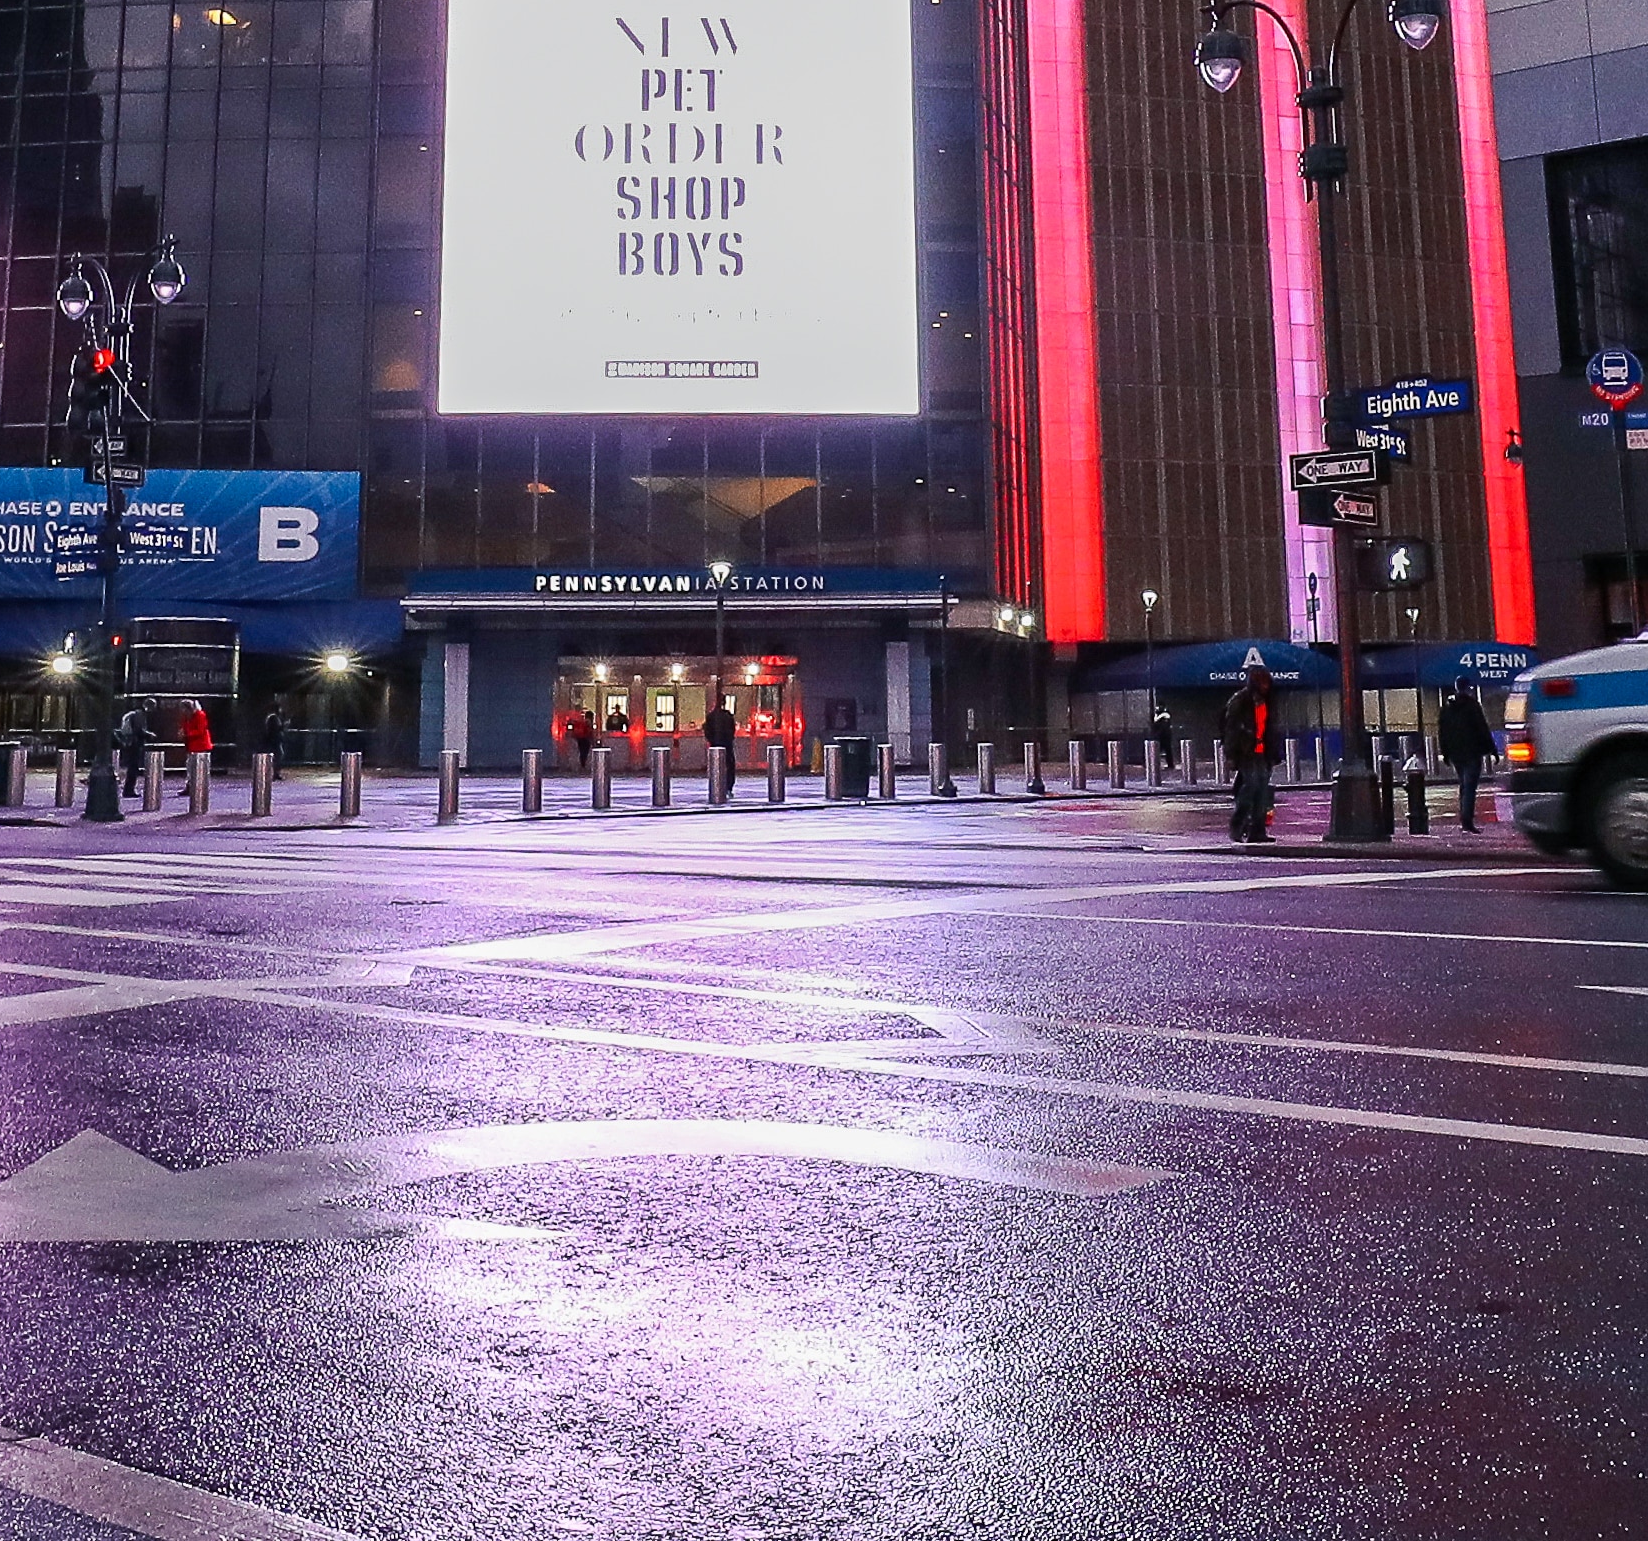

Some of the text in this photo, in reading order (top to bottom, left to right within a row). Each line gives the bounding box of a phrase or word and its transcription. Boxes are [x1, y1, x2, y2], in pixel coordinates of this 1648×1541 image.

[641, 69, 723, 111] PET
[574, 123, 784, 165] ORDER
[616, 176, 746, 220] SHOP
[617, 232, 745, 277] BOYS
[1367, 389, 1459, 418] Eighth Ave
[1582, 413, 1609, 426] M20
[1356, 429, 1378, 448] West
[1396, 436, 1407, 455] St
[1306, 461, 1362, 477] ONE WAY
[57, 533, 82, 550] Eighth
[83, 533, 98, 545] Ave
[129, 532, 154, 546] West
[173, 536, 184, 548] St
[258, 506, 320, 562] B
[67, 561, 85, 573] Louis
[536, 575, 825, 592] PENNSYLVANIA STATION
[1242, 647, 1265, 668] A
[1459, 653, 1526, 668] 4 PENN
[1479, 670, 1509, 678] WEST
